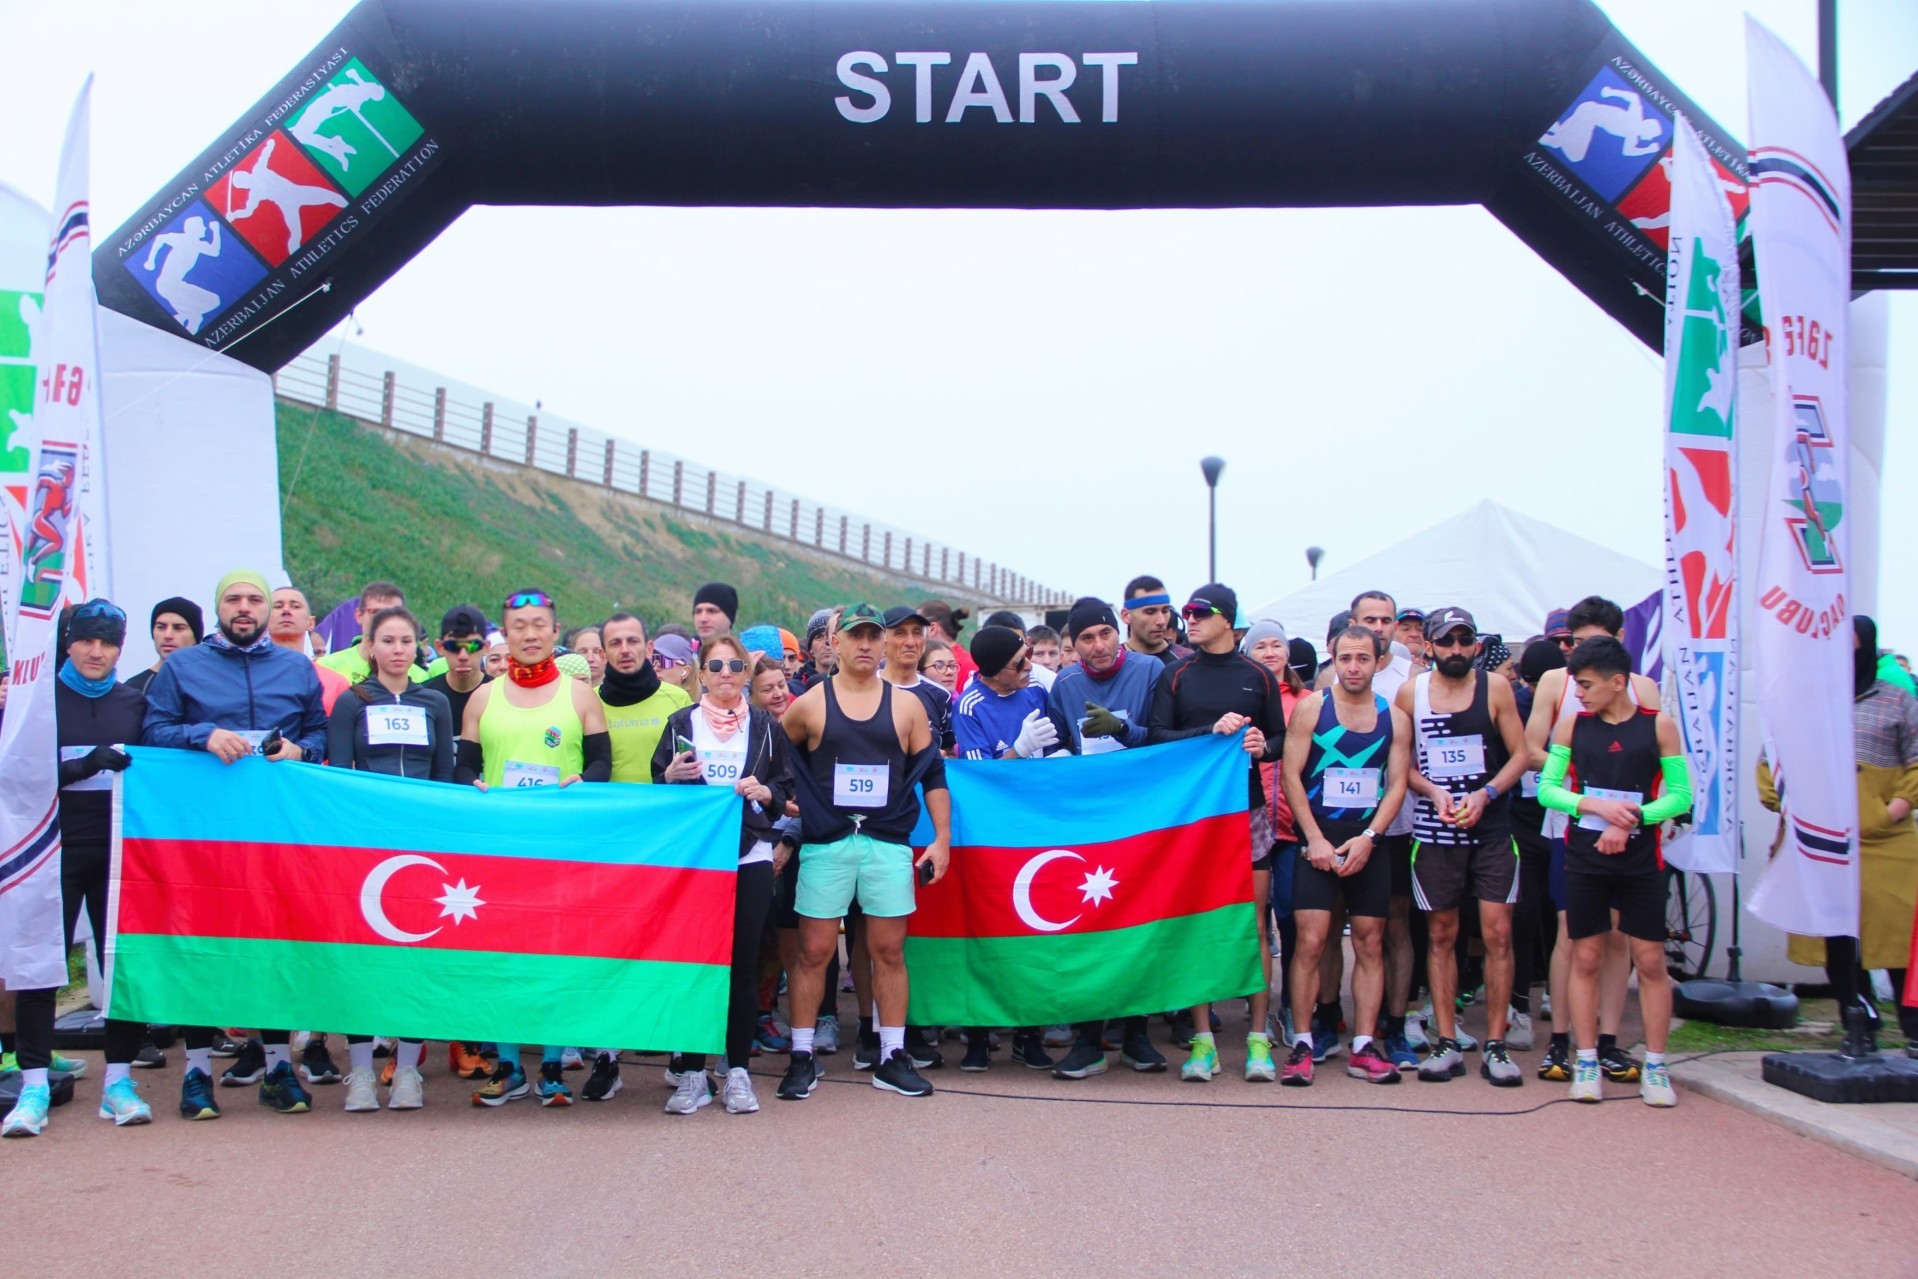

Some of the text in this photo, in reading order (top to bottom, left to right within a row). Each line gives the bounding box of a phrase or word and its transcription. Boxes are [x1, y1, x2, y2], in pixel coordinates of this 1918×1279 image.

[834, 50, 1138, 124] START
[1611, 55, 1691, 124] AZƏRBAYC
[1523, 151, 1604, 219] AZERBAIJAN
[118, 182, 199, 257] AZƏRBAYCAN
[204, 138, 440, 348] AZERBAIJAN ATHLETICS FEDERATION
[12, 652, 45, 686] KLU
[384, 717, 410, 731] 163
[707, 763, 738, 779] 509
[1441, 750, 1466, 763] 135
[849, 778, 874, 793] 519
[1339, 781, 1361, 795] 141
